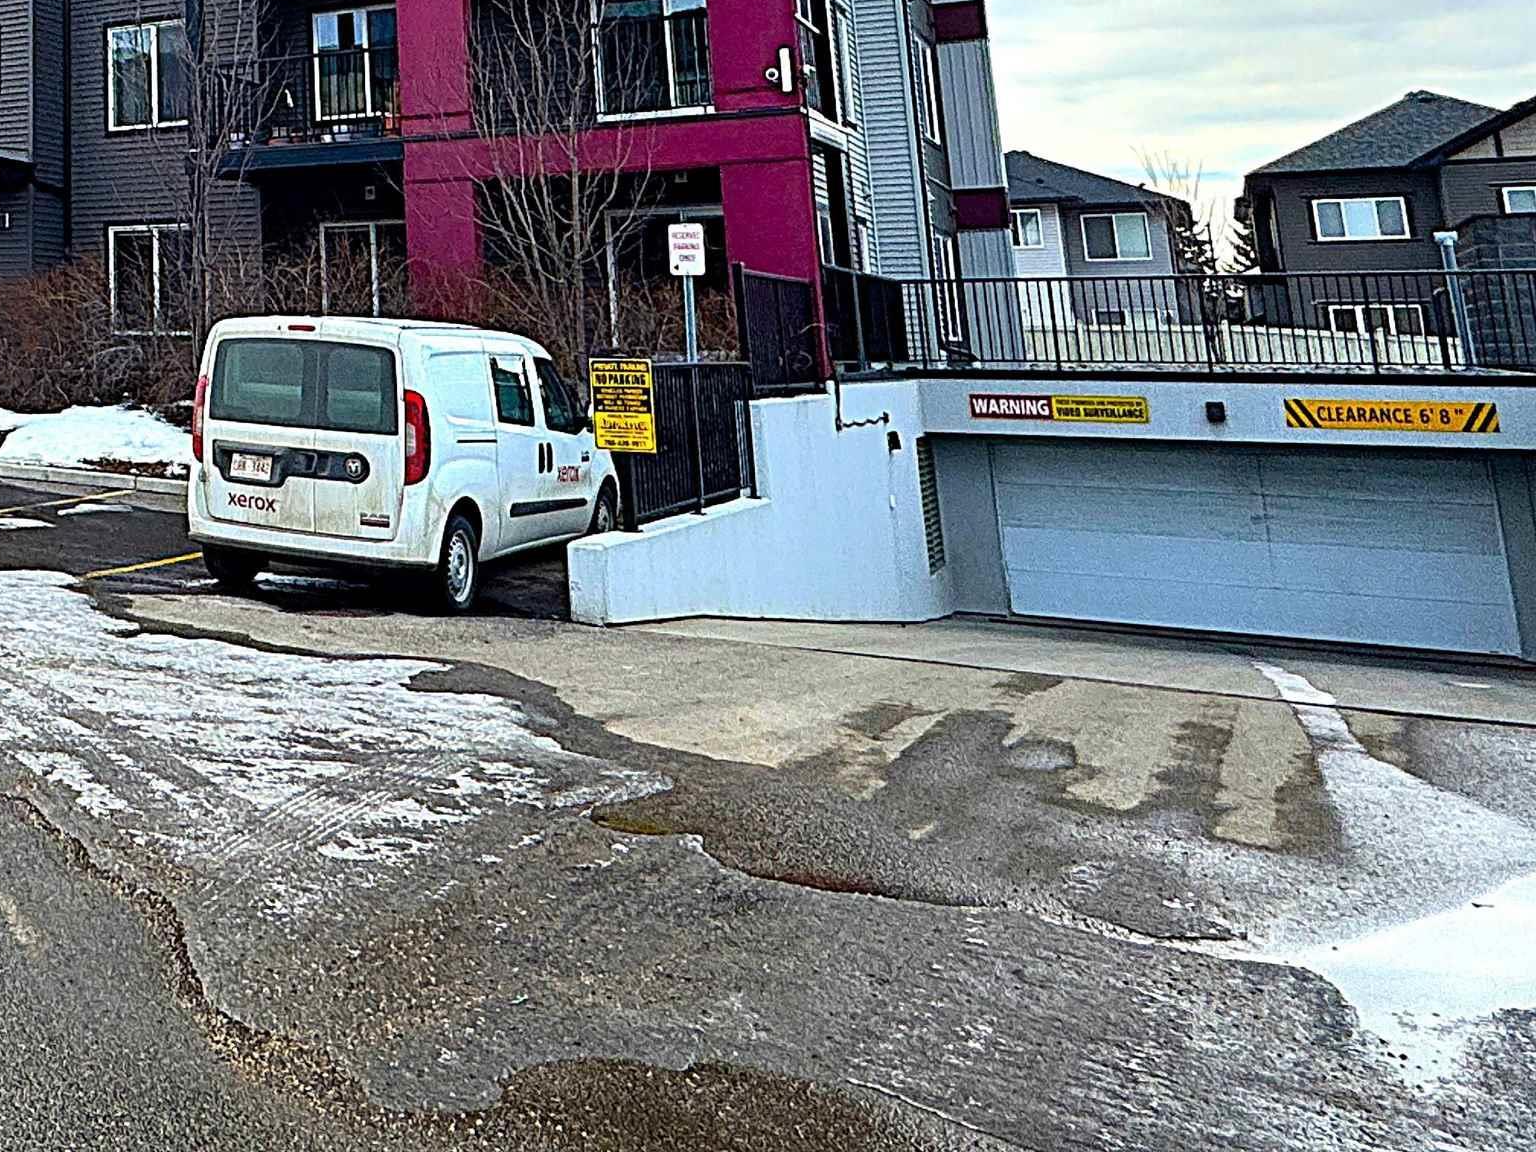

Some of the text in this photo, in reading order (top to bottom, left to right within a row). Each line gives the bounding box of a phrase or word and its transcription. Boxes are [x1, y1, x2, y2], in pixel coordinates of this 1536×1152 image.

[595, 374, 646, 386] NO PARKING
[972, 399, 1050, 416] WARNING
[1316, 406, 1414, 424] CLEARANCE
[1419, 407, 1434, 425] 6'
[227, 492, 277, 513] xerox
